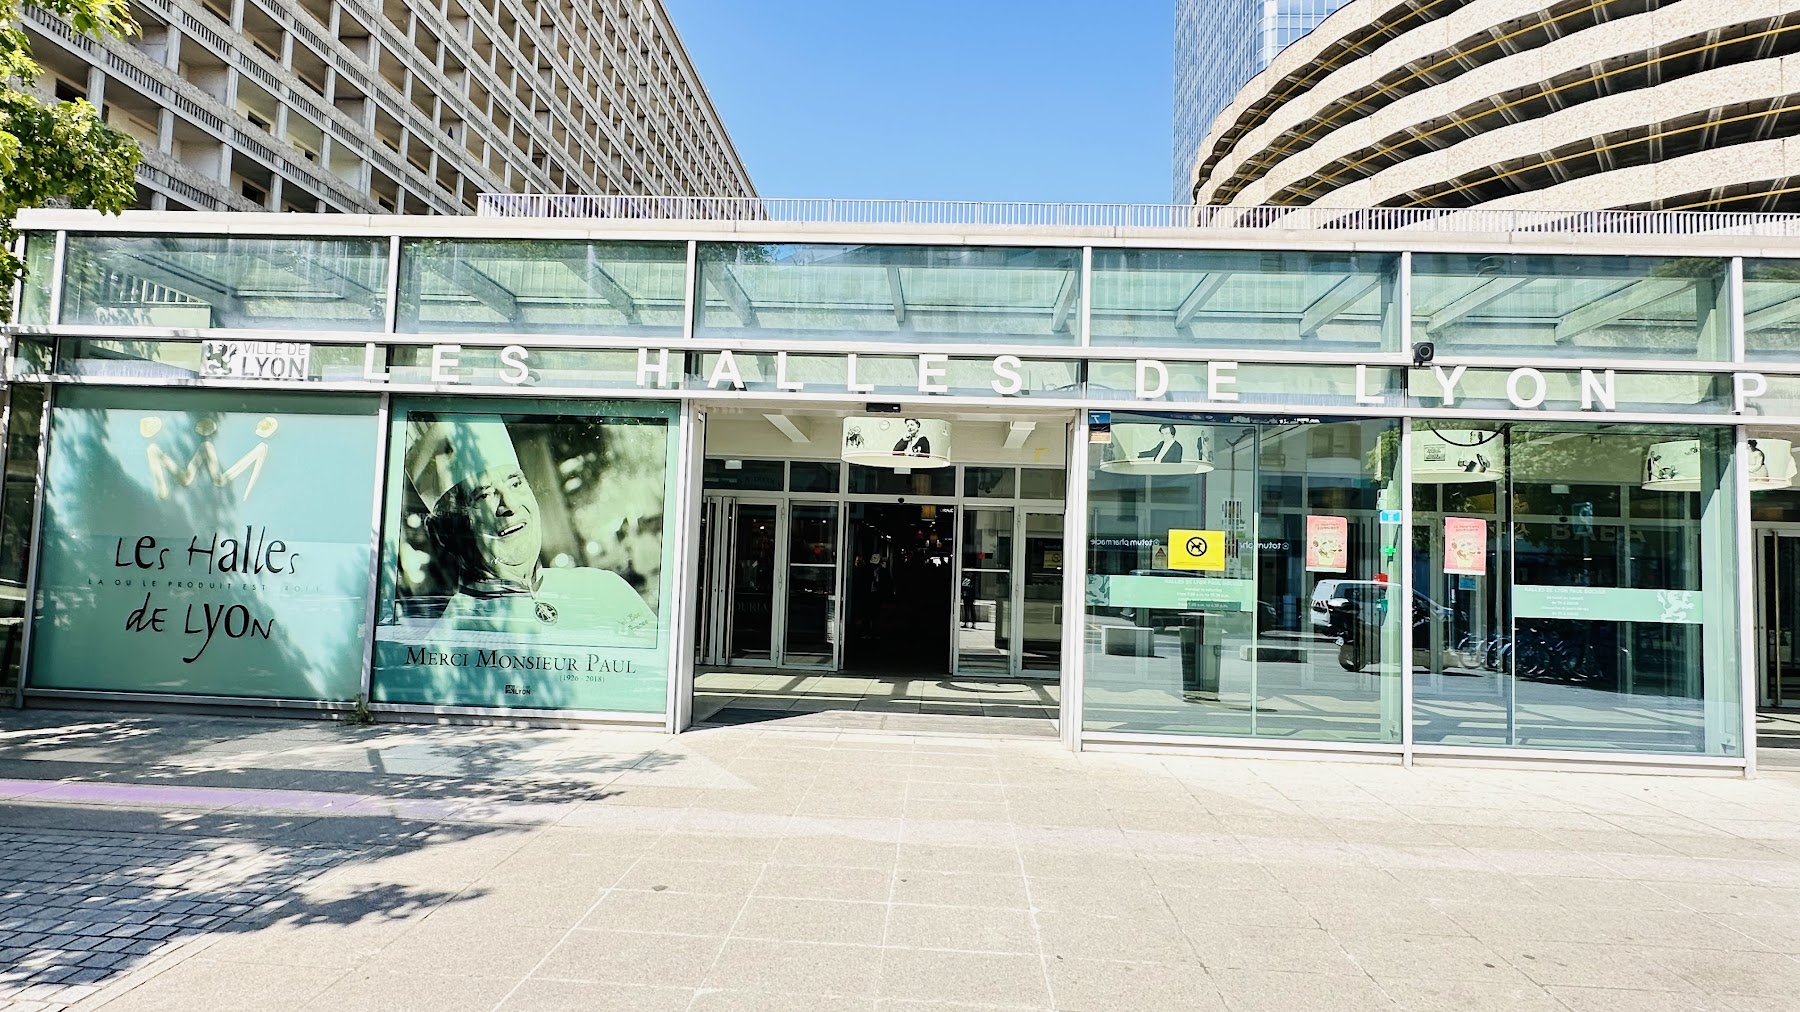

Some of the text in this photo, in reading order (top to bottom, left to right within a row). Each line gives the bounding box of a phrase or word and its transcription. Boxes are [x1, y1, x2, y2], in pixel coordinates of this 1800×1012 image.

[243, 342, 307, 356] VILLE DE
[241, 356, 305, 378] LYON
[363, 342, 531, 385] LES
[635, 347, 1024, 394] HALLES
[1135, 358, 1240, 401] DE
[1354, 363, 1617, 410] LYON
[115, 524, 300, 577] Les Halles
[88, 578, 104, 586] LA
[143, 579, 157, 588] LE
[168, 580, 232, 590] PRODUIT
[242, 582, 265, 592] EST
[404, 646, 637, 675] MERCI MONSIEUR PAUL
